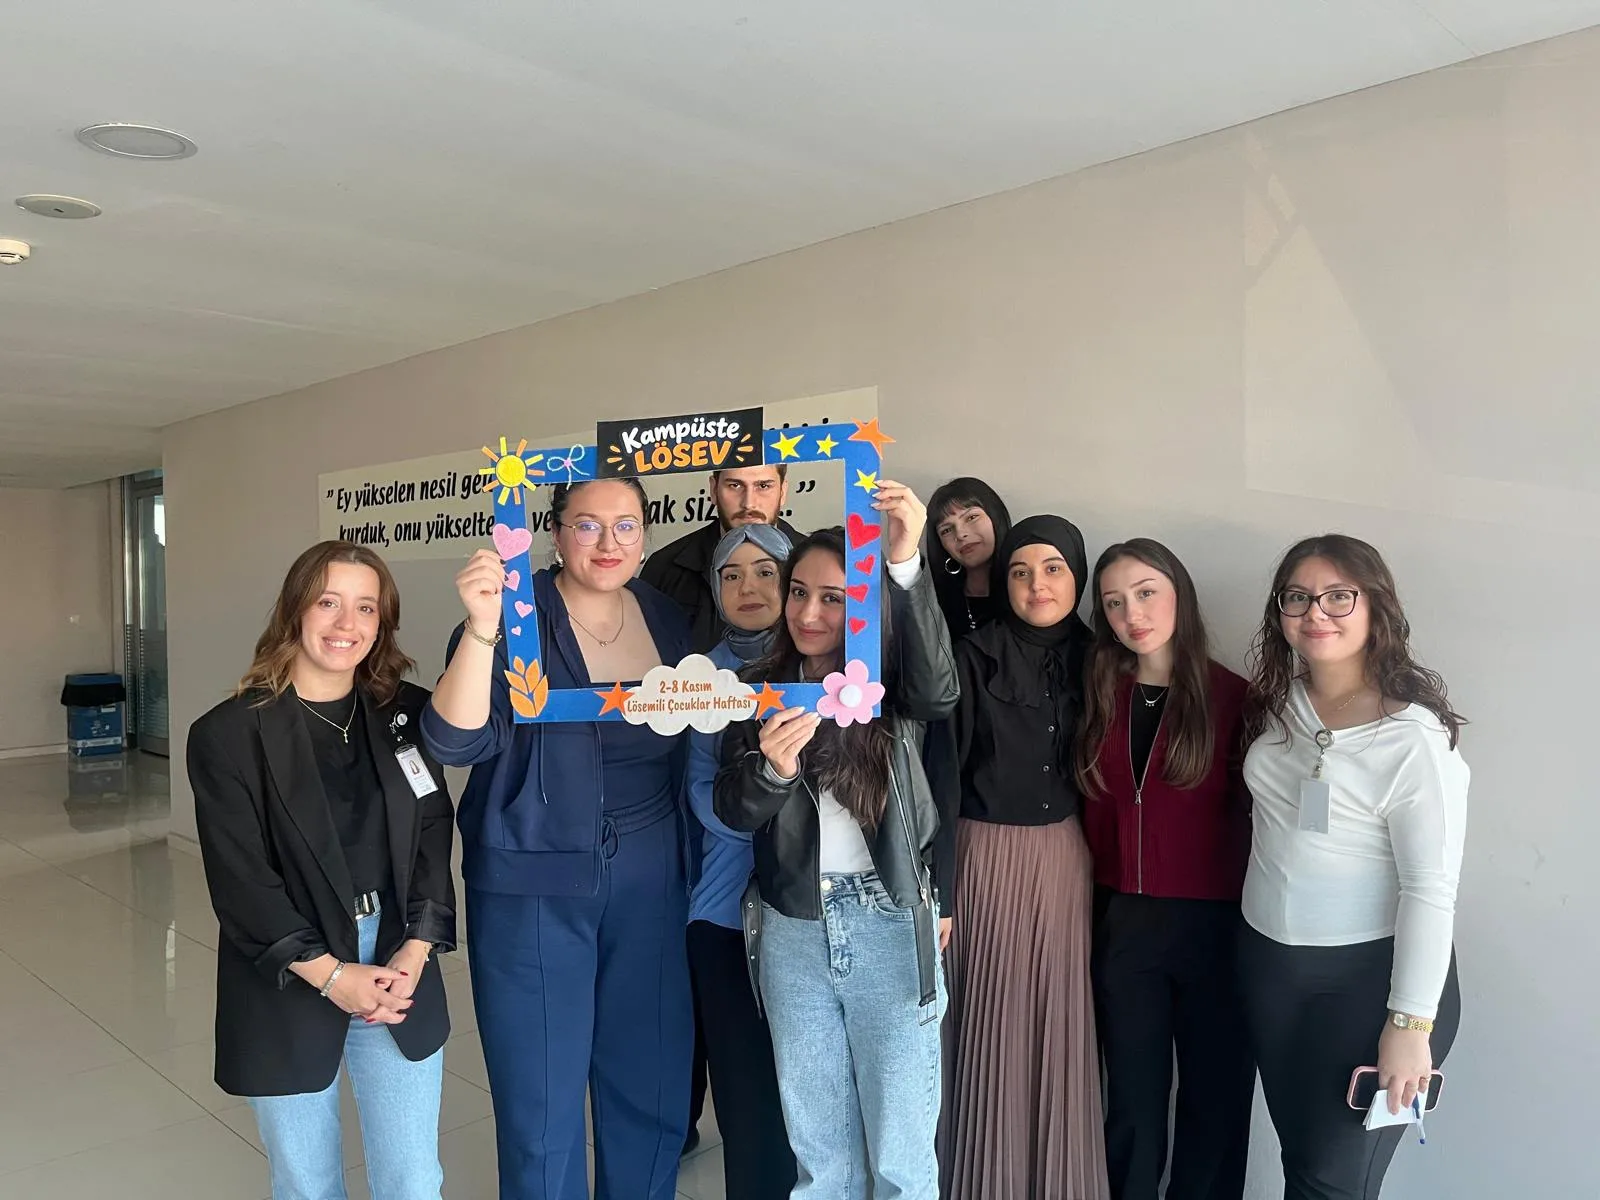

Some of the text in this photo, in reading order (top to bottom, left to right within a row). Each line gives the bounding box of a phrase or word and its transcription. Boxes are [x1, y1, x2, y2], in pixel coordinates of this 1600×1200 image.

[621, 417, 740, 454] Kampüste
[634, 440, 732, 473] LÖSEV
[354, 481, 415, 511] yükselen
[420, 472, 456, 500] nesil
[339, 521, 389, 548] kurduk,
[394, 520, 421, 542] onu
[659, 680, 713, 694] 2-8 Kasım
[627, 696, 751, 714] Lösemili Çocuklar Haftası
